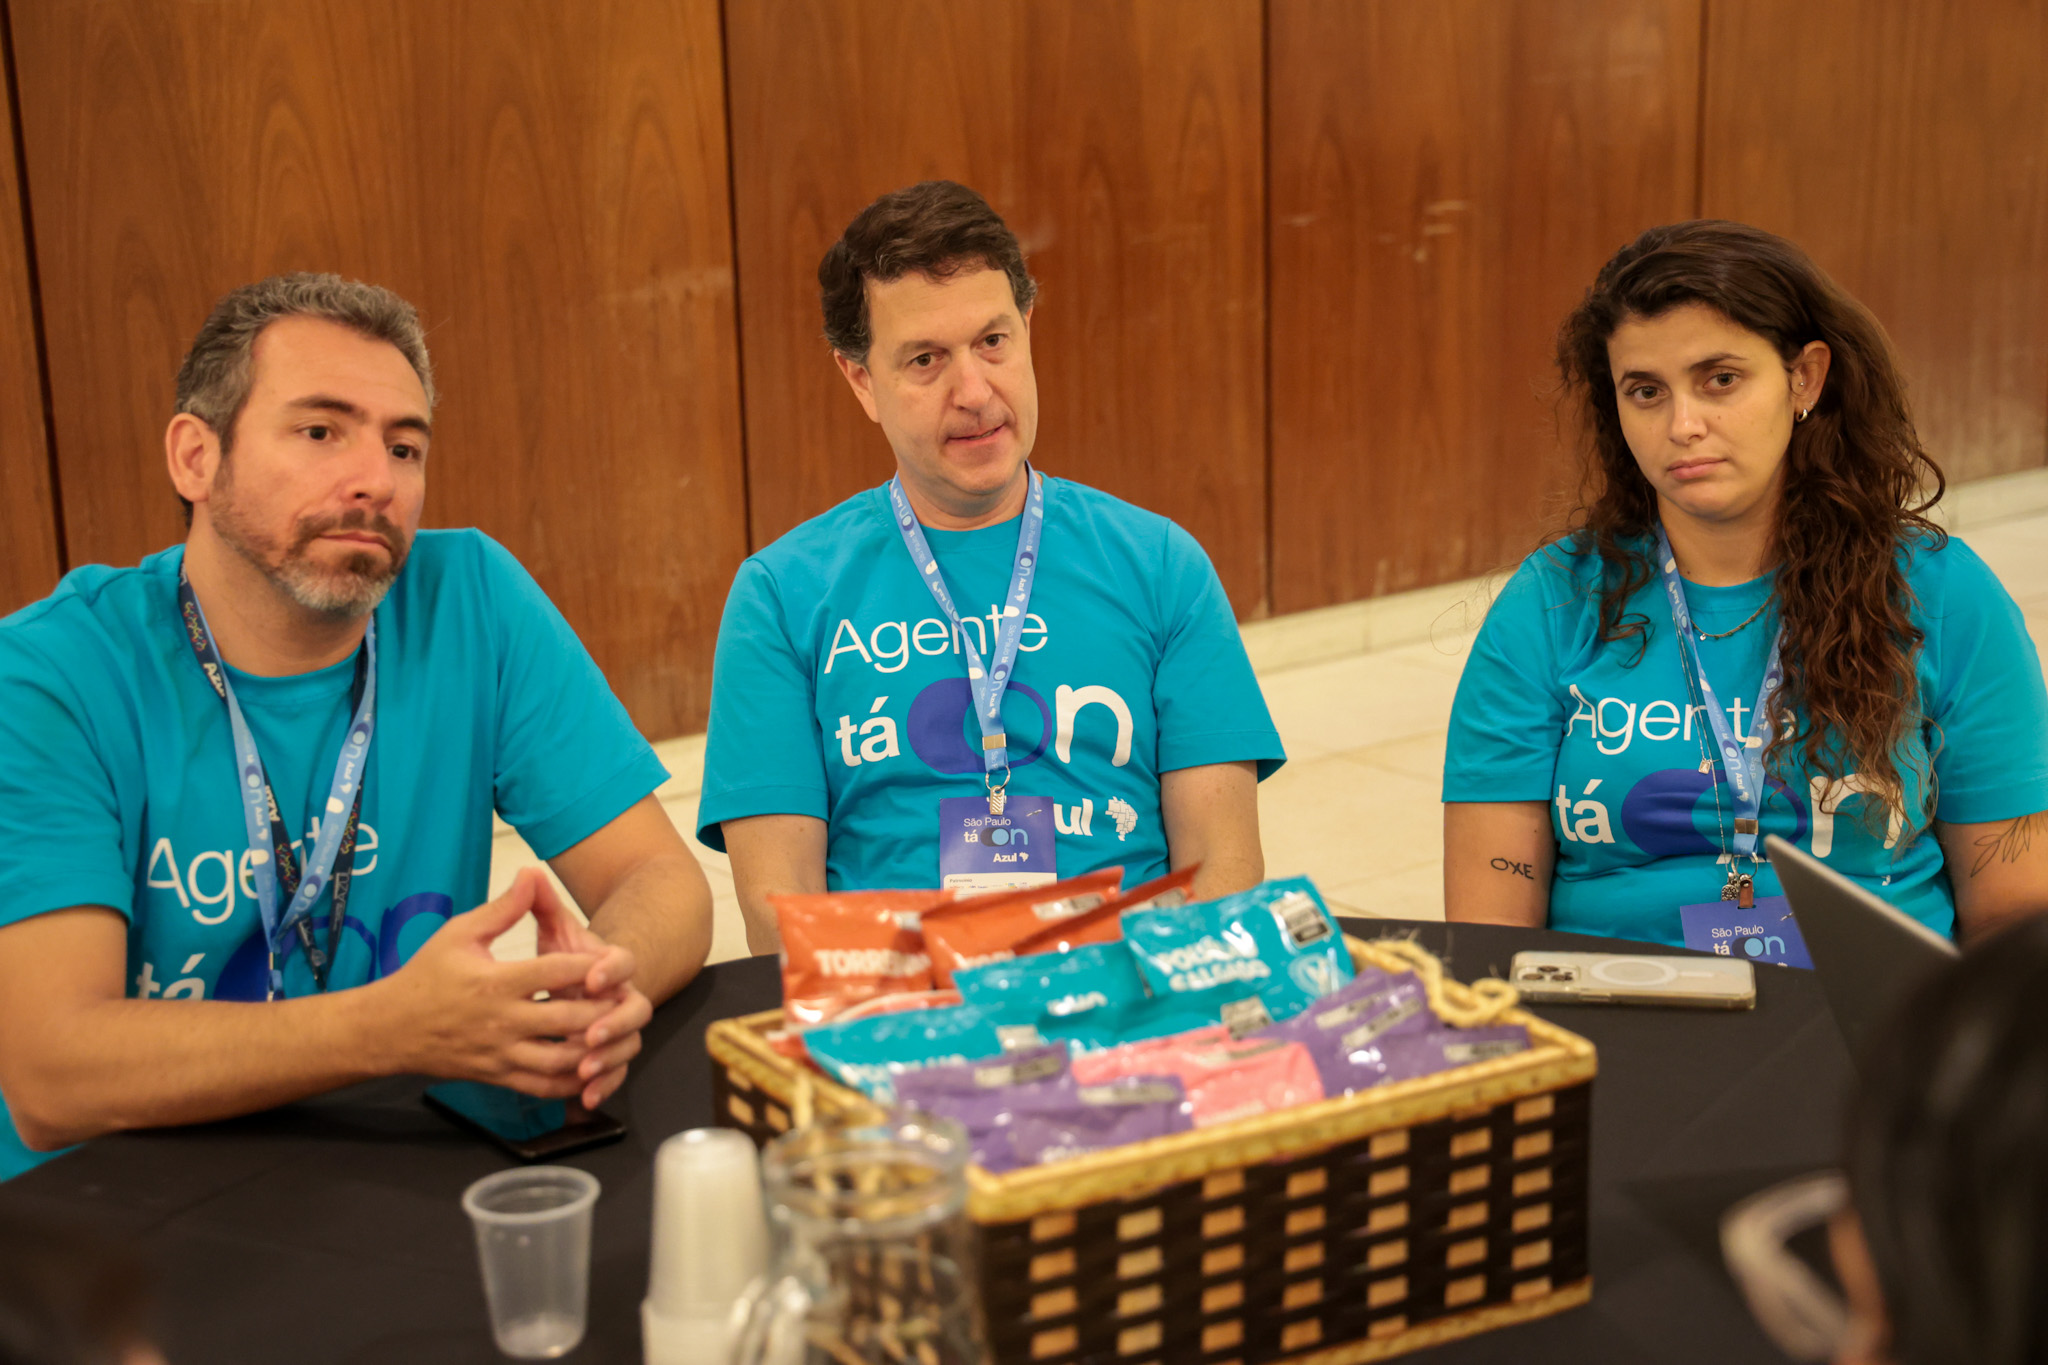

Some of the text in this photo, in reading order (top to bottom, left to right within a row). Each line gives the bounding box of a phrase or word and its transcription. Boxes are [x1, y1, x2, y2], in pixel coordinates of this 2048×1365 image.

[824, 604, 1048, 674] Agente
[835, 697, 900, 766] tá
[1734, 772, 1745, 790] Azul
[1053, 798, 1093, 836] ul
[1556, 779, 1615, 844] tá
[964, 816, 1012, 828] São Paulo
[964, 830, 978, 843] tá
[993, 852, 1018, 862] Azul
[1490, 858, 1534, 880] OXE
[1711, 924, 1764, 938] São Paulo
[1713, 940, 1731, 956] tá
